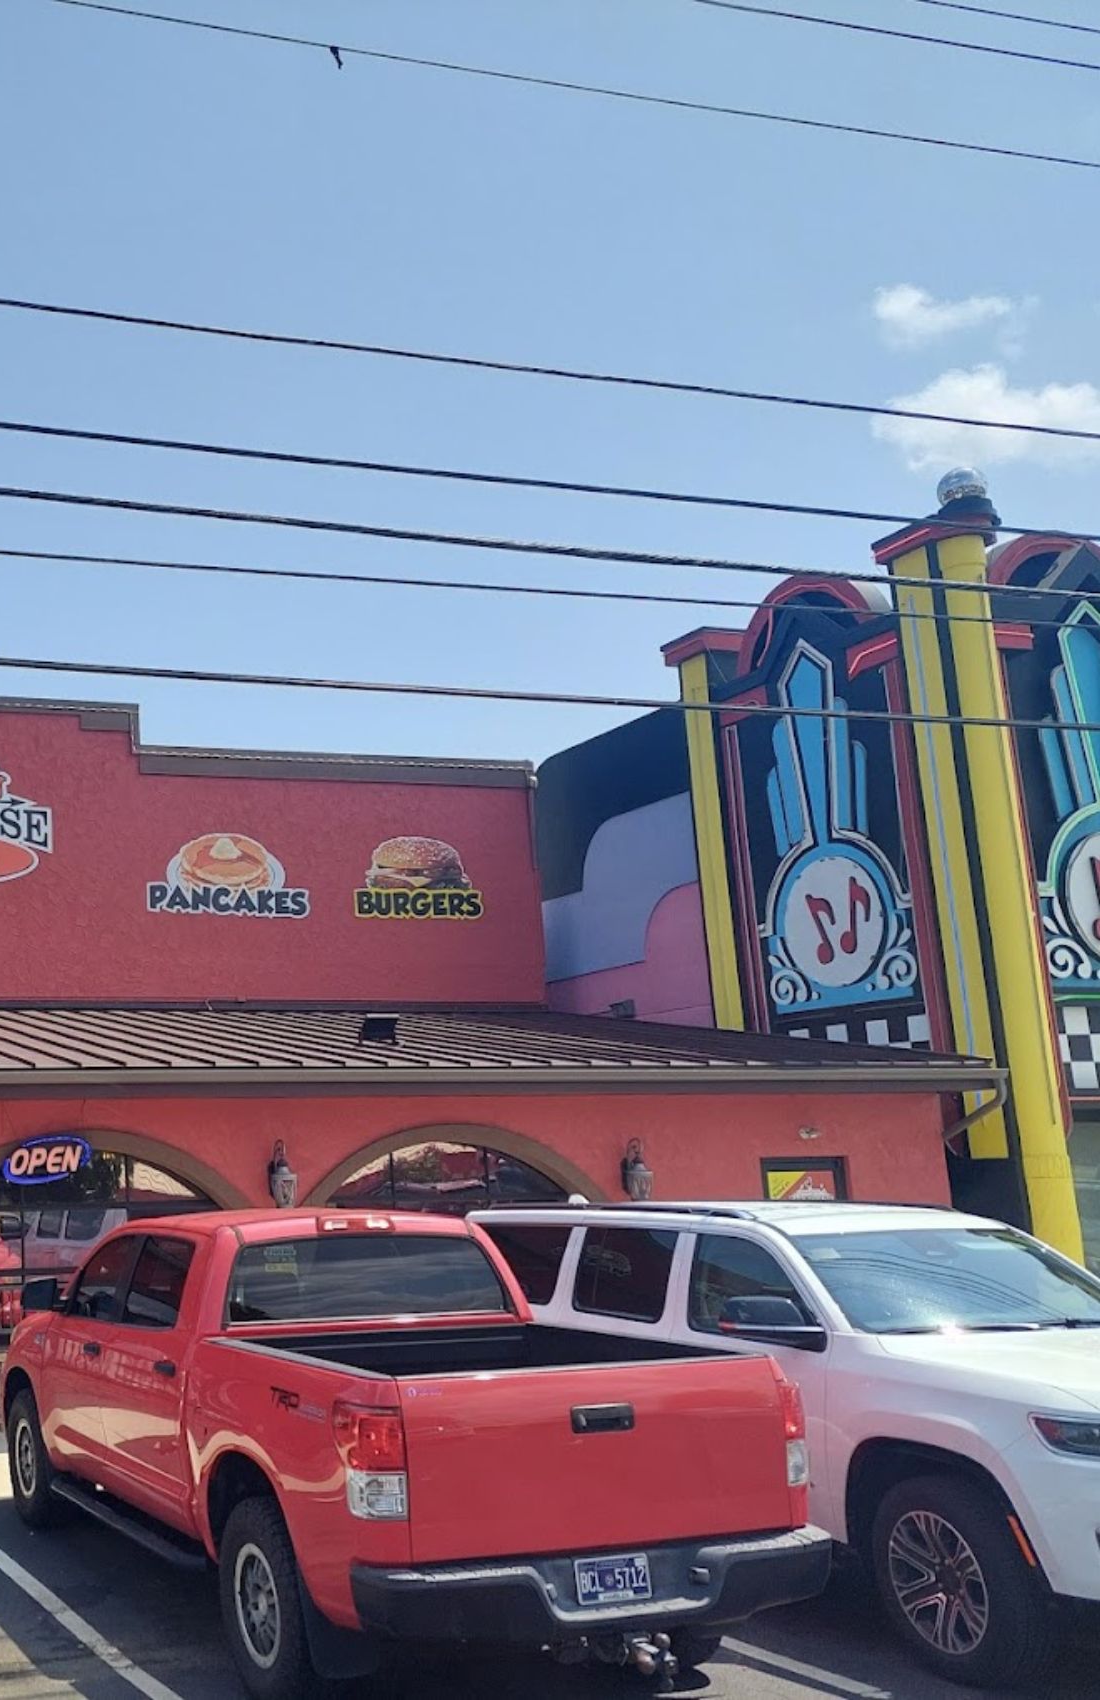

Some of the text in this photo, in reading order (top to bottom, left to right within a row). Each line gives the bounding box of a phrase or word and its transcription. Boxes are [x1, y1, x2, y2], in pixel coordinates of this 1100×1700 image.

[148, 883, 308, 917] PANCAKES
[356, 890, 482, 918] BURGERS
[9, 1145, 82, 1175] OPEN
[270, 1386, 299, 1411] TRD
[580, 1566, 647, 1594] BCL 5712
